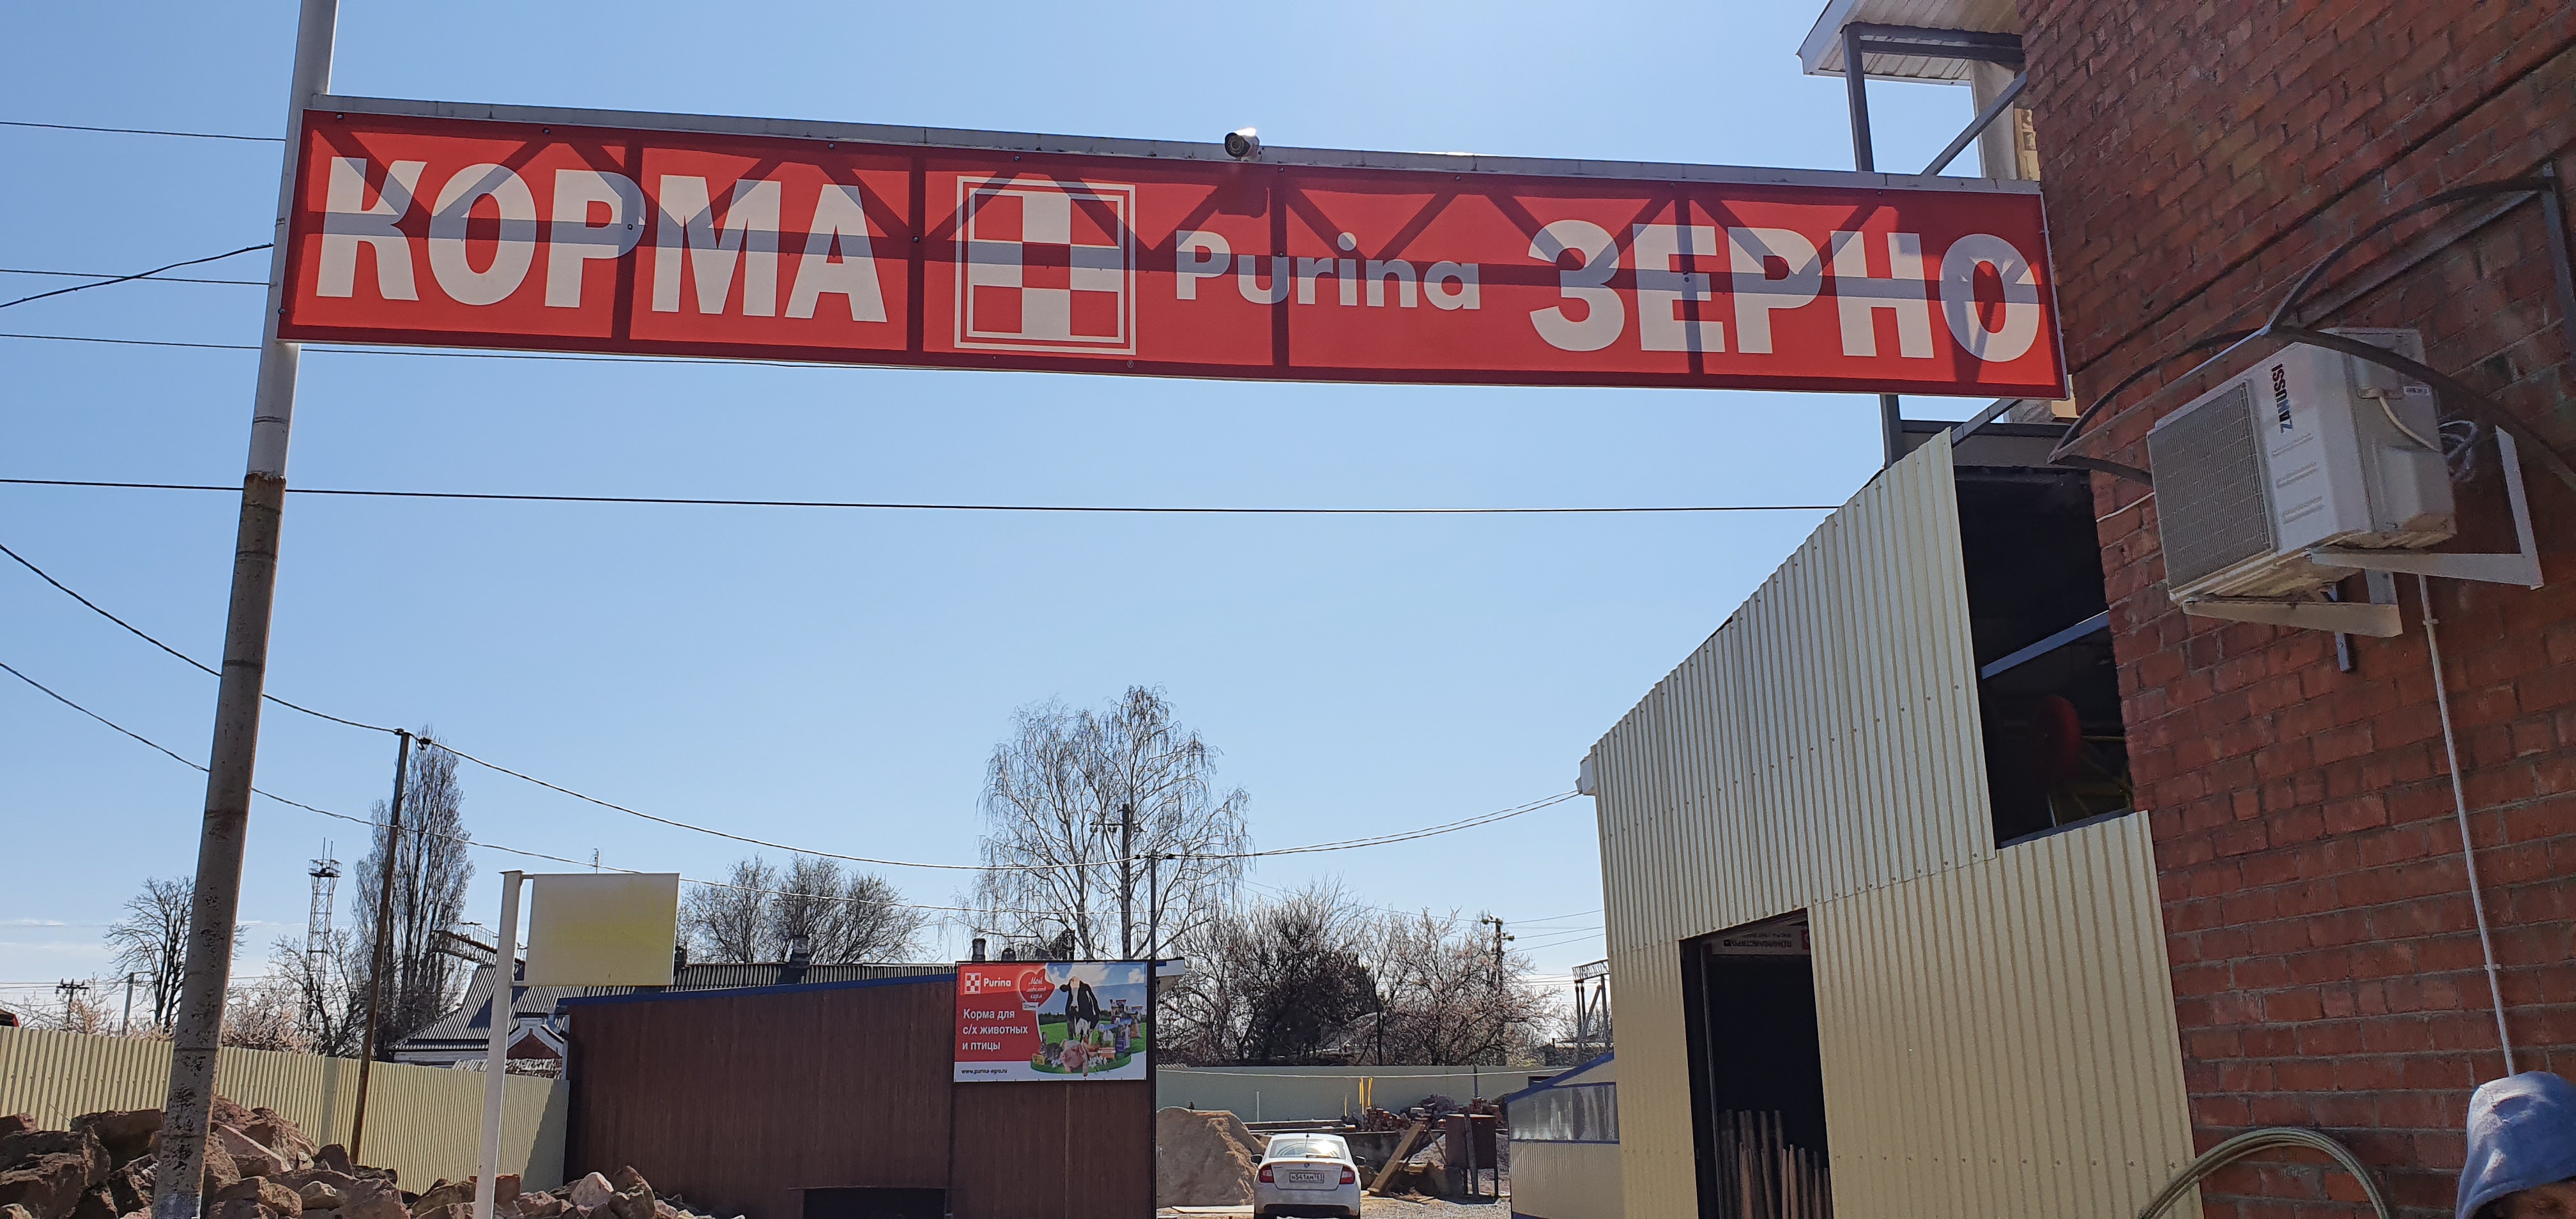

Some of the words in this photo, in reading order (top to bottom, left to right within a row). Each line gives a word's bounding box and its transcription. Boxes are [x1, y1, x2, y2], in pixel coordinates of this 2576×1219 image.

[316, 156, 887, 323] КОРМА
[1176, 229, 1480, 310] Purina
[1528, 218, 2040, 362] ЗЕРНО
[2271, 363, 2293, 434] ZANUSSI
[983, 977, 1011, 987] Purina
[962, 1023, 977, 1035] с/х
[979, 1026, 1028, 1034] животных
[963, 1008, 995, 1021] Корма
[997, 1010, 1015, 1021] для
[962, 1042, 968, 1050] и
[970, 1042, 1000, 1052] птицы
